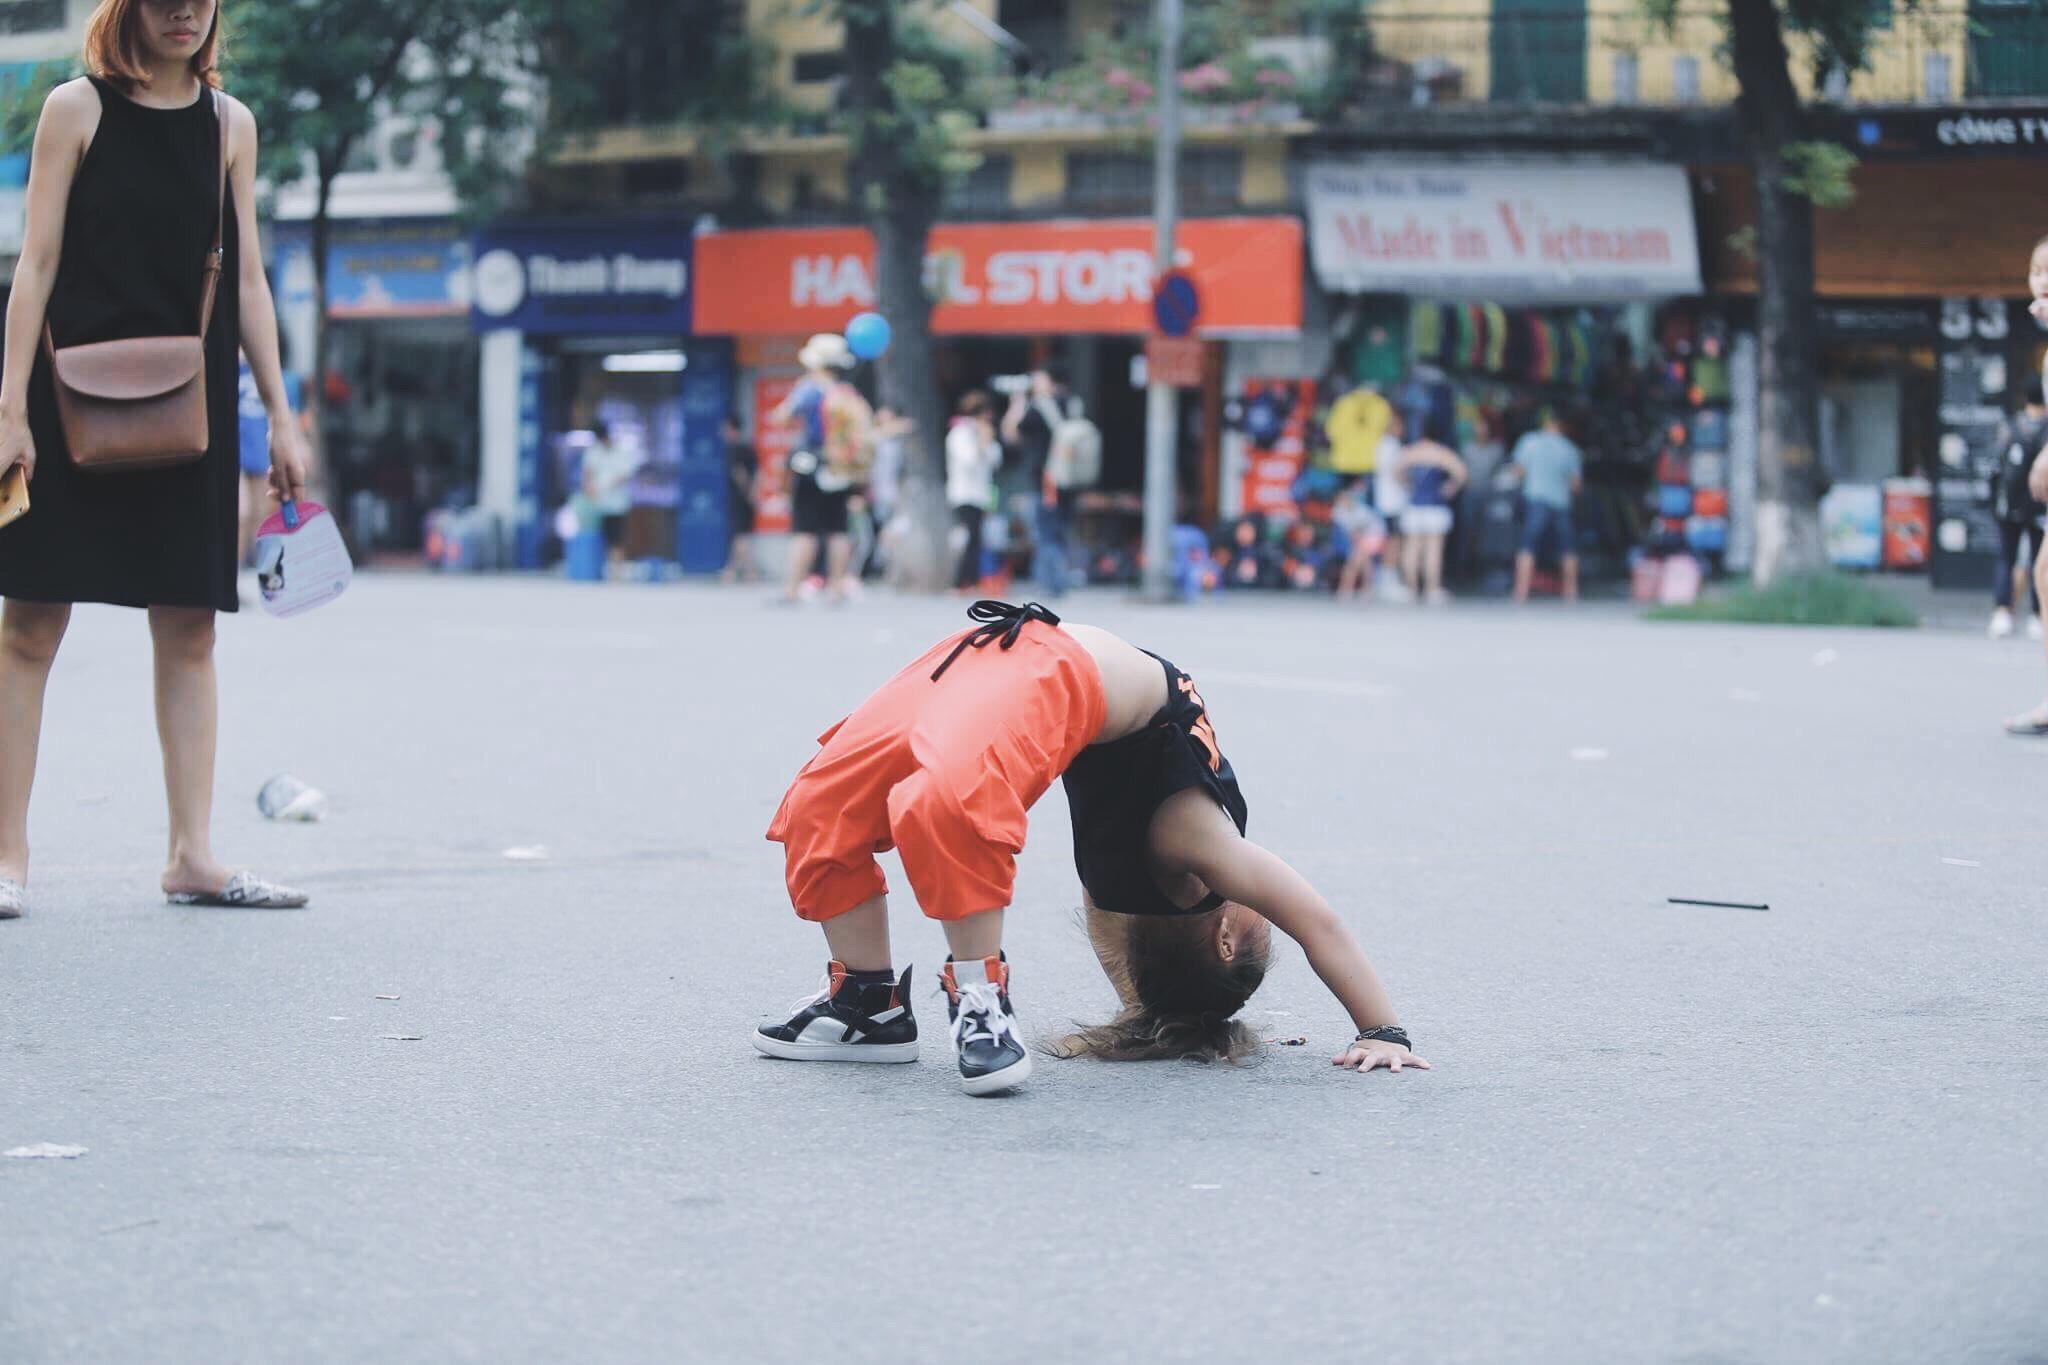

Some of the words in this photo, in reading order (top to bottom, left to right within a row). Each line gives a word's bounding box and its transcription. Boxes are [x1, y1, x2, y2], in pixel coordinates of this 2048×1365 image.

[1335, 211, 1438, 260] Made
[1449, 213, 1490, 260] in
[791, 252, 981, 306] HAL
[985, 248, 1193, 304] STOR
